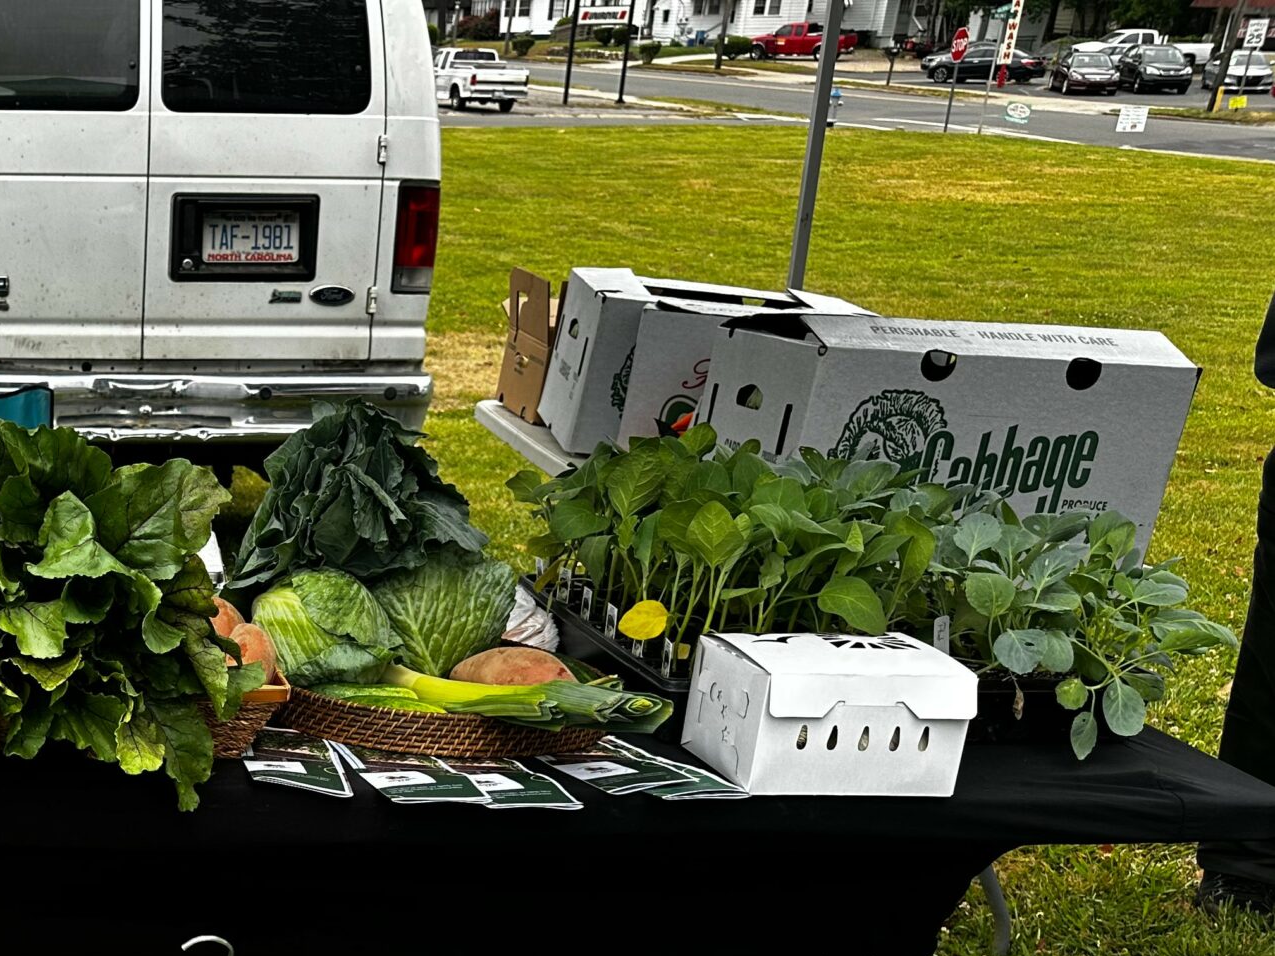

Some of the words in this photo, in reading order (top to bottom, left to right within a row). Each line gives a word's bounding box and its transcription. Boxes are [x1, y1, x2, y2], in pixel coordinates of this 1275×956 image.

[951, 38, 968, 53] STOP
[1003, 22, 1018, 59] WASH
[1246, 33, 1263, 44] 25
[209, 224, 293, 250] TAF-1981
[208, 253, 241, 261] NORTH
[245, 252, 293, 261] CAROLINA
[869, 325, 961, 338] PERISHABLE
[978, 330, 1036, 343] HANDLE
[1037, 333, 1076, 344] WITH
[1077, 335, 1118, 347] CARE
[915, 424, 1099, 514] Cabbage
